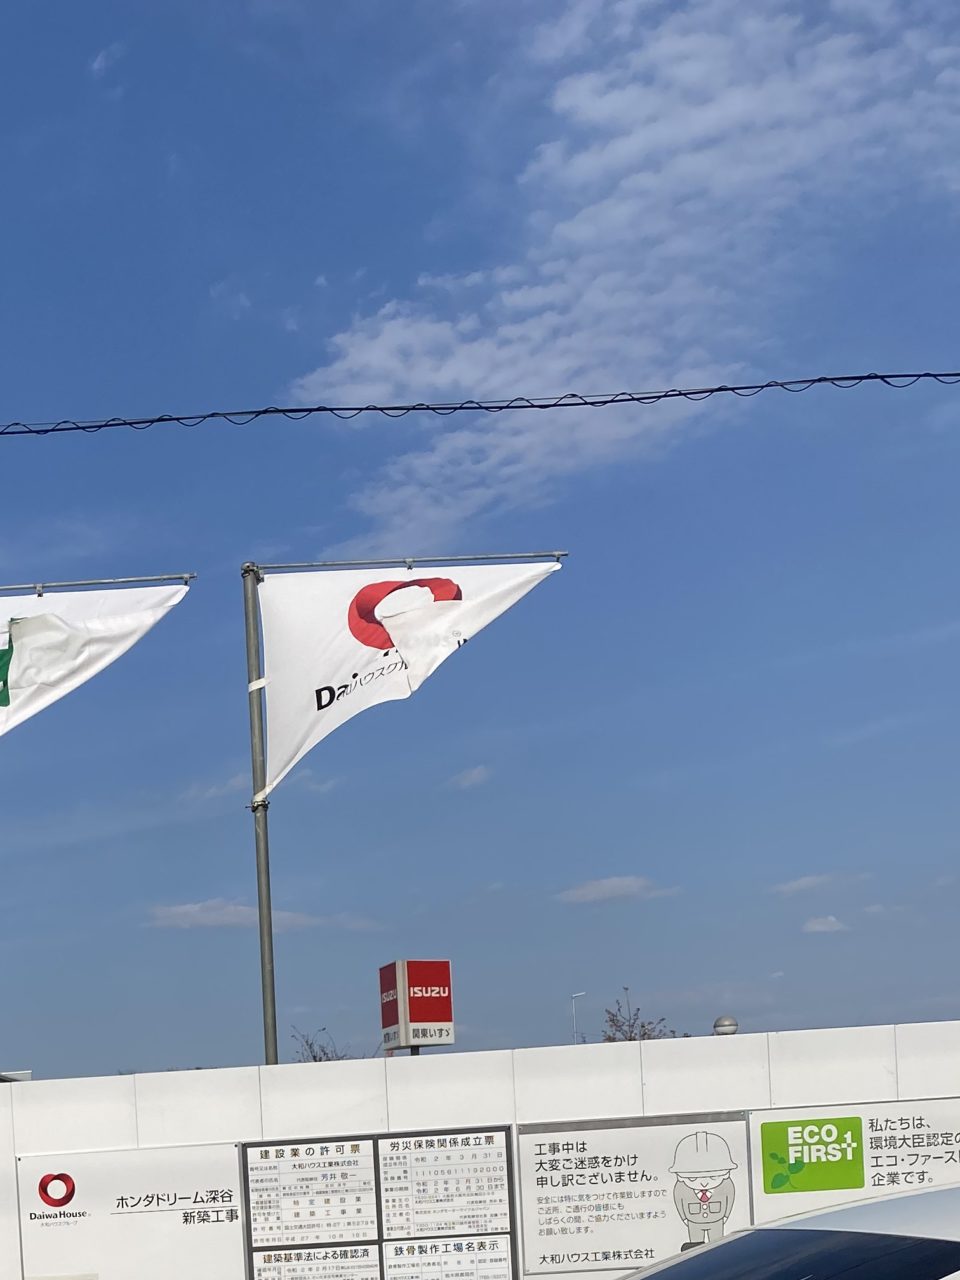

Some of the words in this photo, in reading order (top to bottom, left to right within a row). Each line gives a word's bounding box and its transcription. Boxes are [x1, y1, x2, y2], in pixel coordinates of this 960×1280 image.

[382, 988, 397, 1003] ISUZU
[410, 986, 449, 997] ISUZU
[869, 1115, 932, 1132] 私たちは、
[787, 1123, 838, 1145] ECO
[390, 1135, 495, 1151] 労災保険関係成立票
[534, 1140, 588, 1156] 工事中は
[260, 1144, 360, 1160] 建設業の許可票
[871, 1150, 960, 1168] エコ・ファース
[291, 1160, 359, 1170] 大和ハウス工業株式会社
[535, 1154, 639, 1172] 大変ご迷惑をかけ
[536, 1170, 659, 1188] 申し訳ございません。
[871, 1170, 934, 1187] 企業です。
[115, 1188, 234, 1209] ホンダドリーム深谷
[29, 1211, 58, 1221] Daiwa
[58, 1210, 88, 1219] House
[182, 1208, 239, 1225] 新築工事
[263, 1248, 370, 1264] 建築基準法による確認済
[394, 1240, 499, 1256] 鉄骨製作工場名表示
[539, 1248, 655, 1265] 大和ハウス工業株式会社
